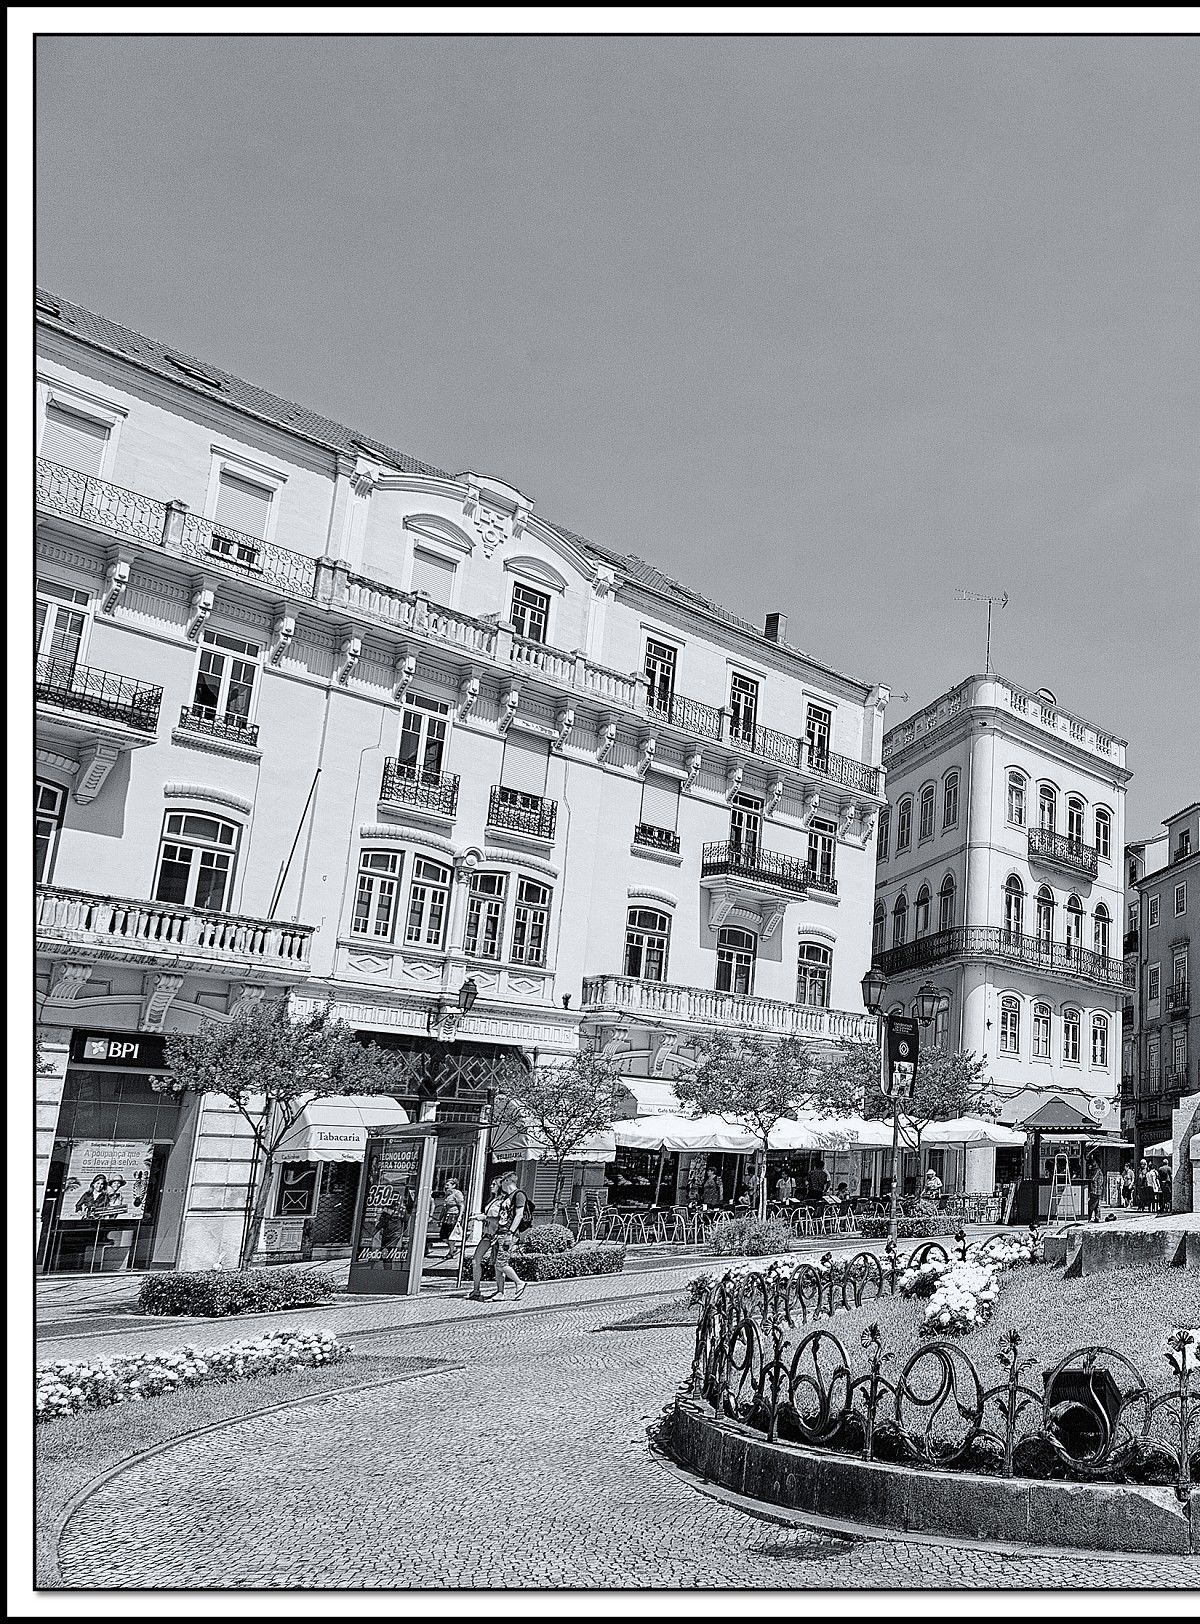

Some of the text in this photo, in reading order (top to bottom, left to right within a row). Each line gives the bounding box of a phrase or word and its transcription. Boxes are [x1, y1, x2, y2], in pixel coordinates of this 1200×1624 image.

[108, 1041, 140, 1059] BPI
[317, 1131, 361, 1142] Tabacaria
[84, 1149, 141, 1159] A poupança que
[379, 1151, 419, 1161] TECNOLOGIA
[93, 1158, 109, 1166] leva
[378, 1161, 419, 1170] PARA TODOS!
